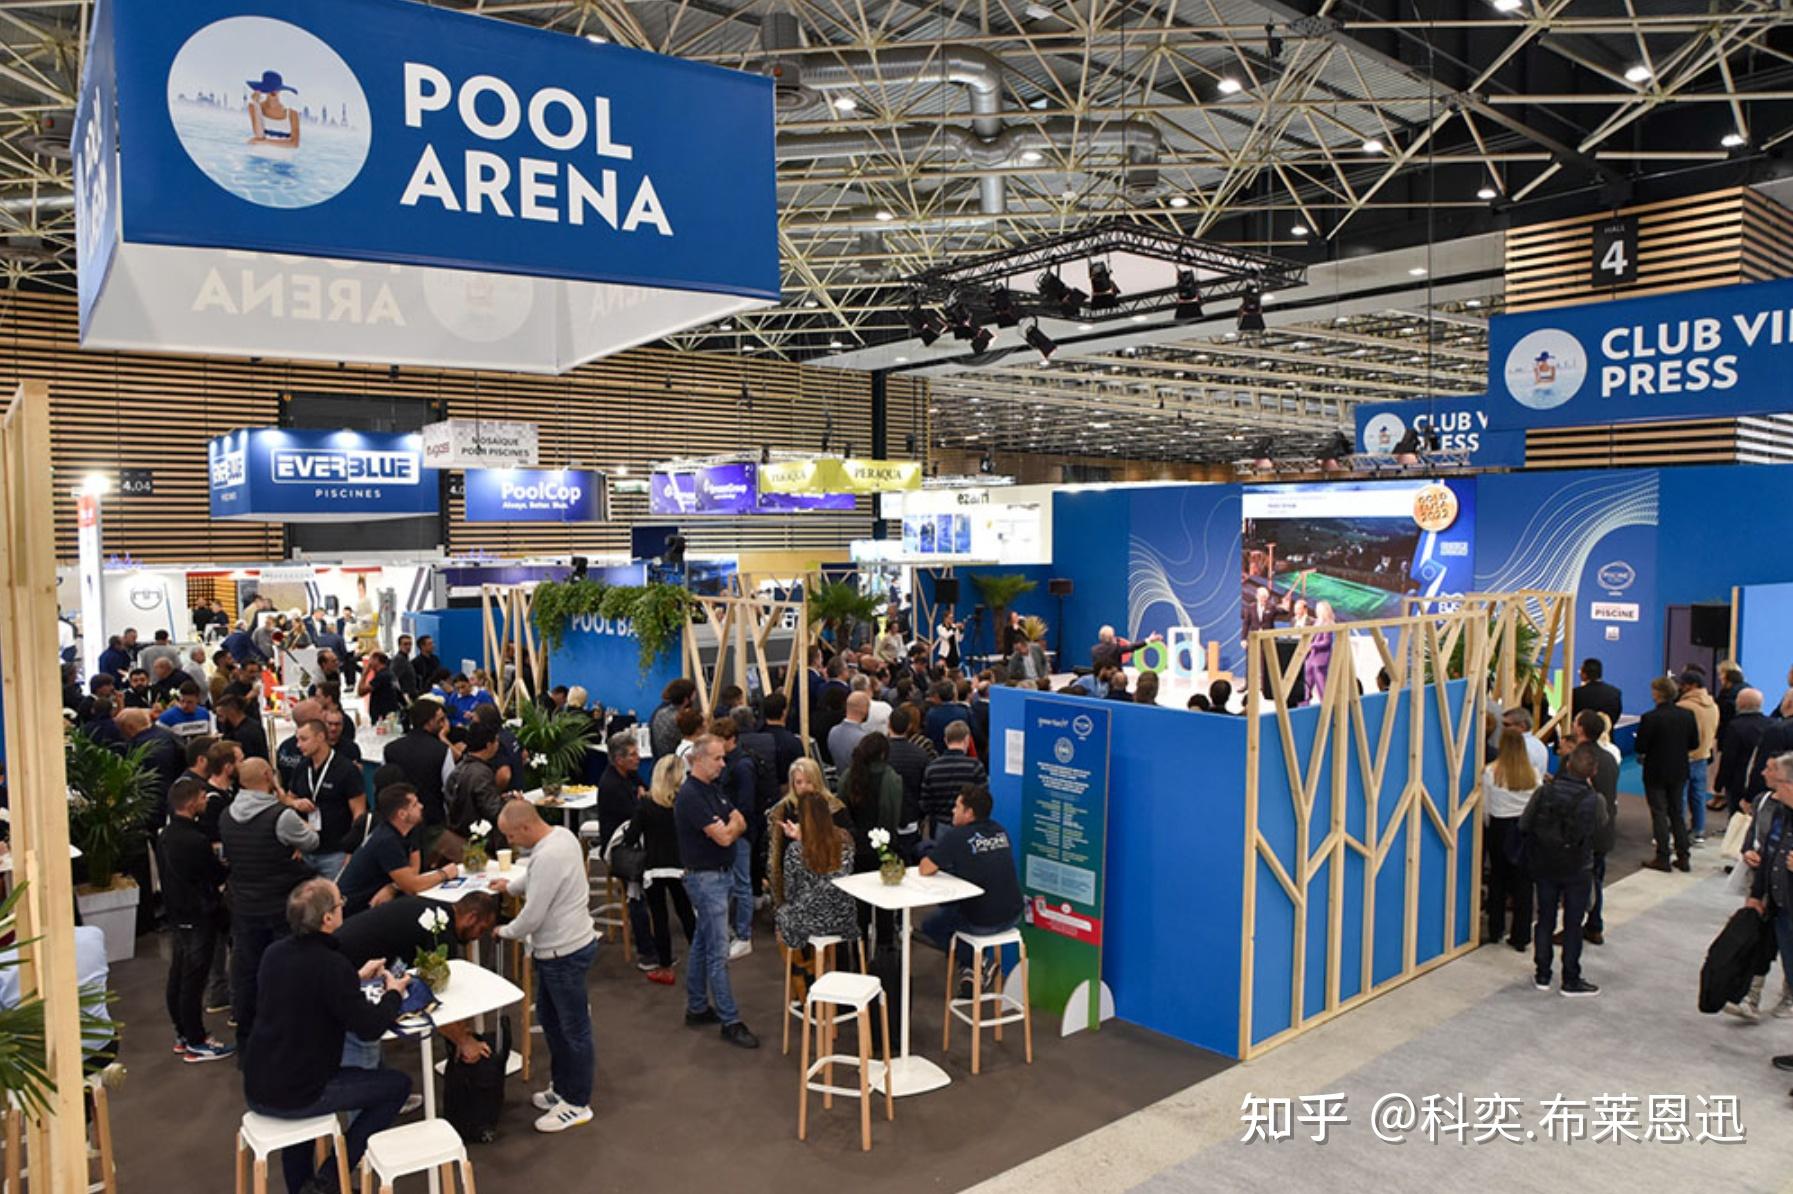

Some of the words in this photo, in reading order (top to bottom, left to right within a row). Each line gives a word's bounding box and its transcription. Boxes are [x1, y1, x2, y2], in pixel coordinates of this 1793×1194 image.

[404, 61, 633, 160] POOL
[400, 143, 674, 236] ARENA
[1600, 240, 1628, 275] 4
[1601, 318, 1722, 360] CLUB
[1732, 307, 1793, 347] VI
[1602, 354, 1738, 397] PRESS
[1413, 411, 1471, 432] CLUB
[489, 448, 530, 457] PISCINES
[277, 455, 411, 479] EVERBLUE
[854, 467, 904, 481] PERAQUA
[122, 480, 151, 492] 4.04
[314, 488, 382, 499] PISCINES
[501, 481, 581, 505] PoolCop
[1420, 508, 1449, 523] 2022
